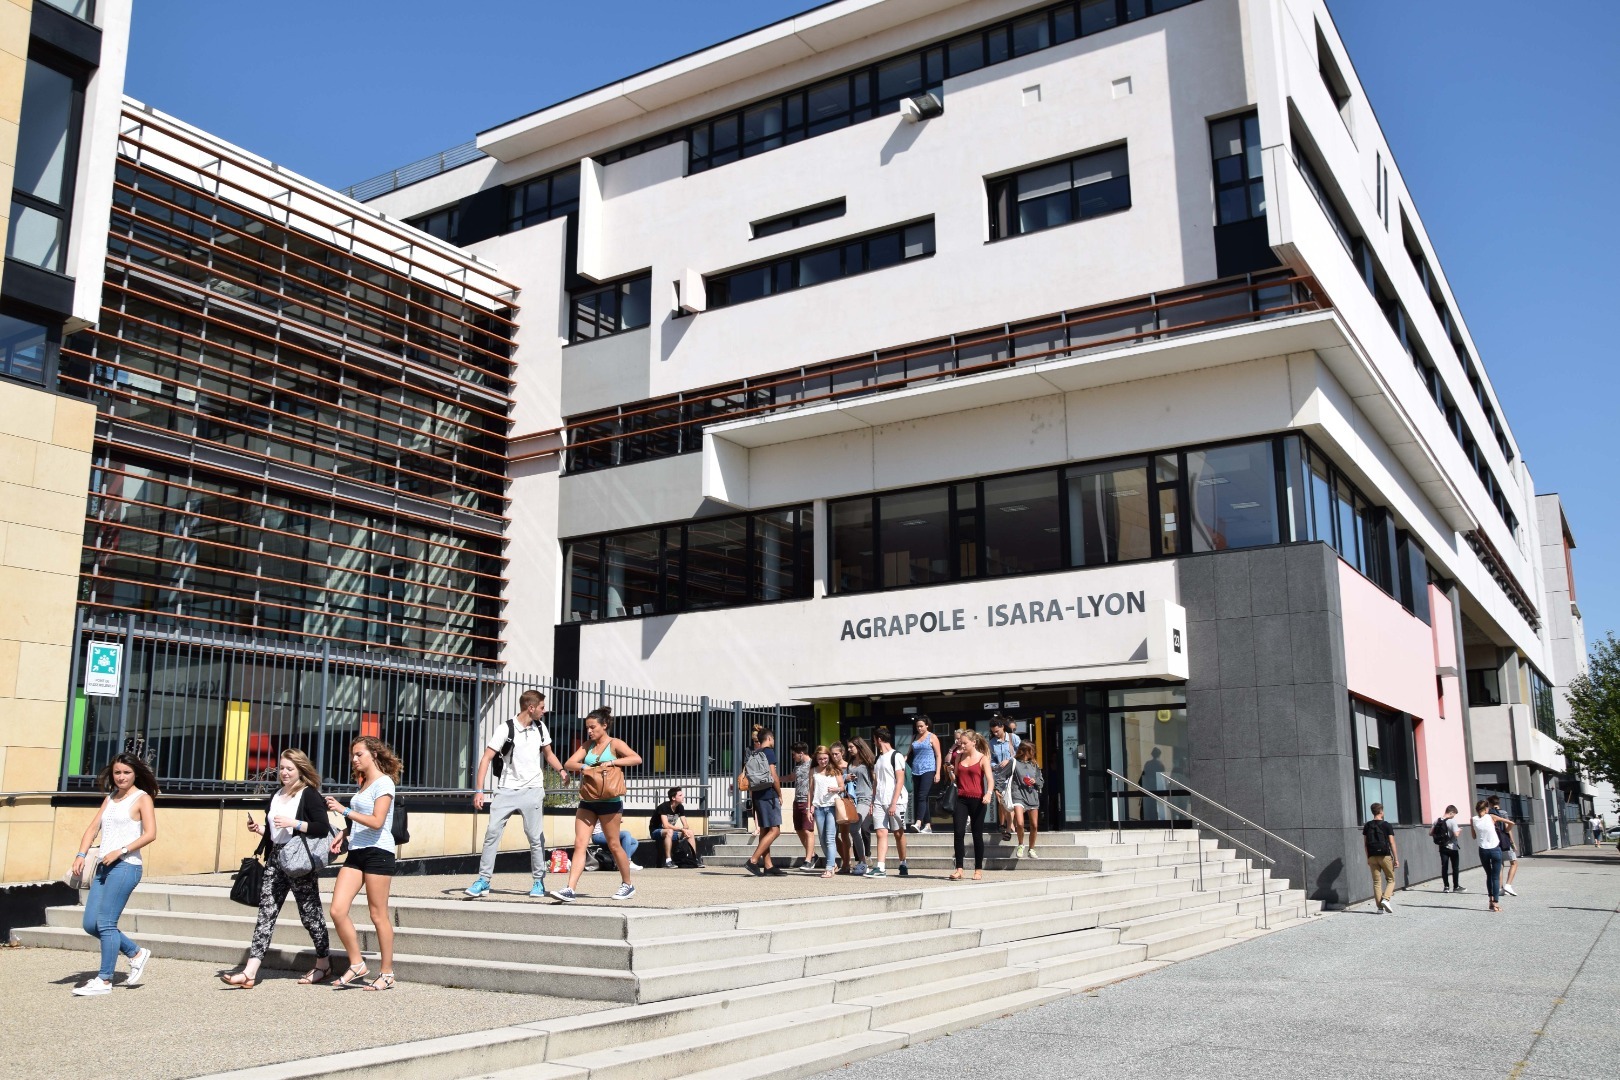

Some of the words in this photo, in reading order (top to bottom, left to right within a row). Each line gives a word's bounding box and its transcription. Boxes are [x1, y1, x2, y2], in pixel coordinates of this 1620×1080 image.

[840, 609, 965, 641] AGRAPOLE
[987, 590, 1146, 627] ISARA-LYON
[1064, 713, 1076, 721] 23
